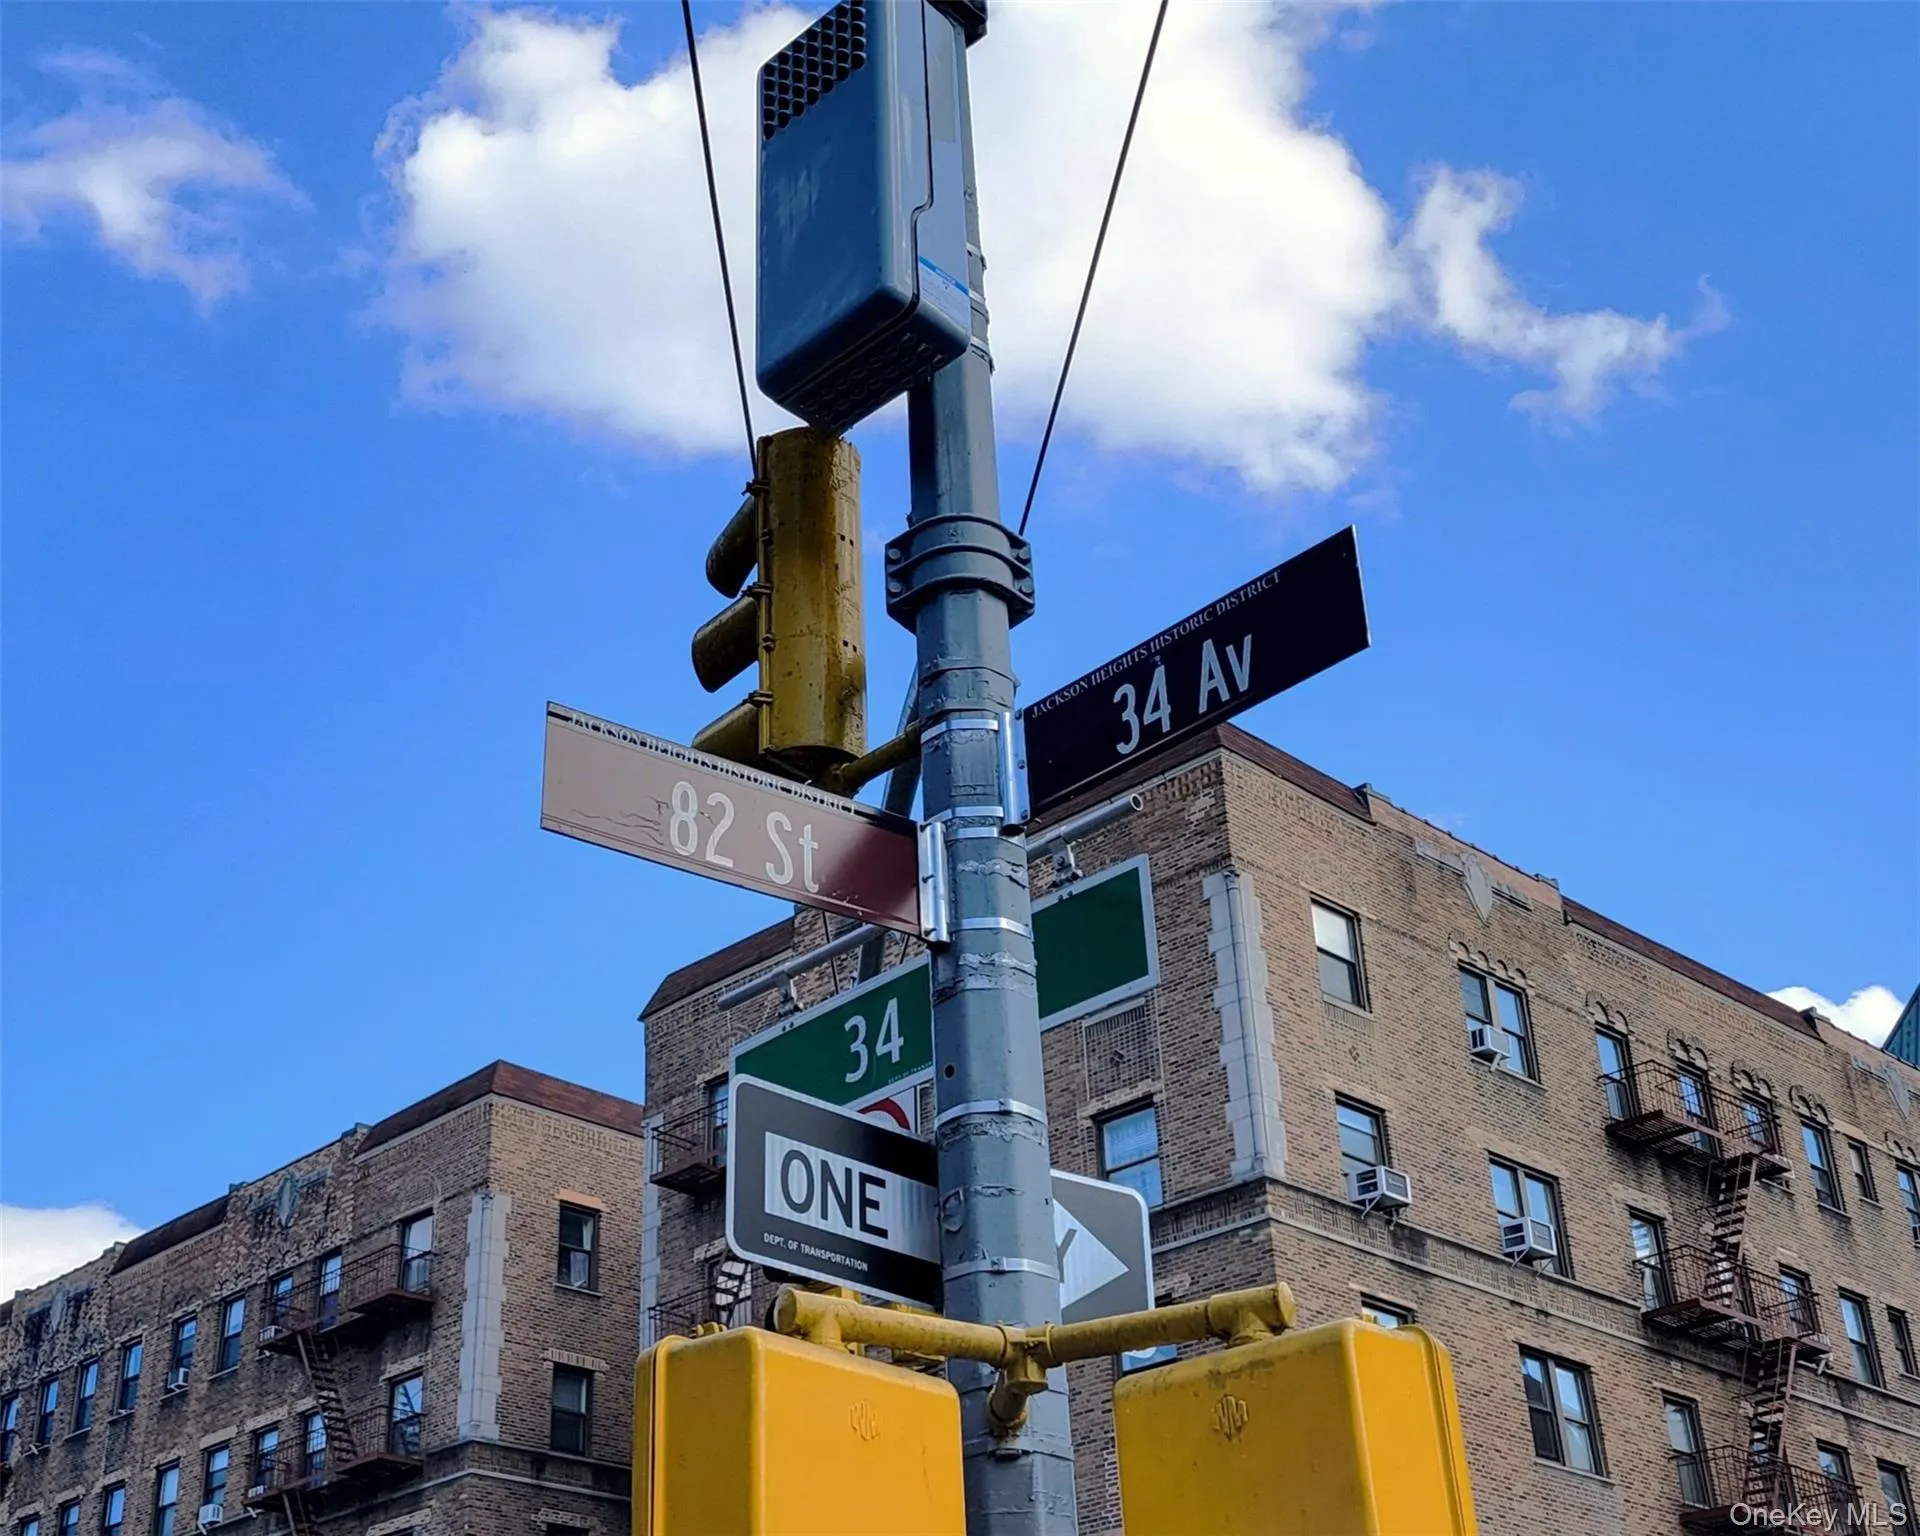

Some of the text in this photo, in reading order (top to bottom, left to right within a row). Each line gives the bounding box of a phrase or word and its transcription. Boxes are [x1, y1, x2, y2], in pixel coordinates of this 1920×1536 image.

[1032, 570, 1280, 718] JACKSON HEIGHTS HISTORIC DISTRICT
[571, 713, 641, 747] JACKSON
[1113, 634, 1252, 754] 34 Av
[669, 781, 819, 893] 82 St
[844, 998, 904, 1083] 34
[780, 1149, 888, 1239] ONE
[763, 1232, 868, 1272] DEPT. OF TRANSPORTATION
